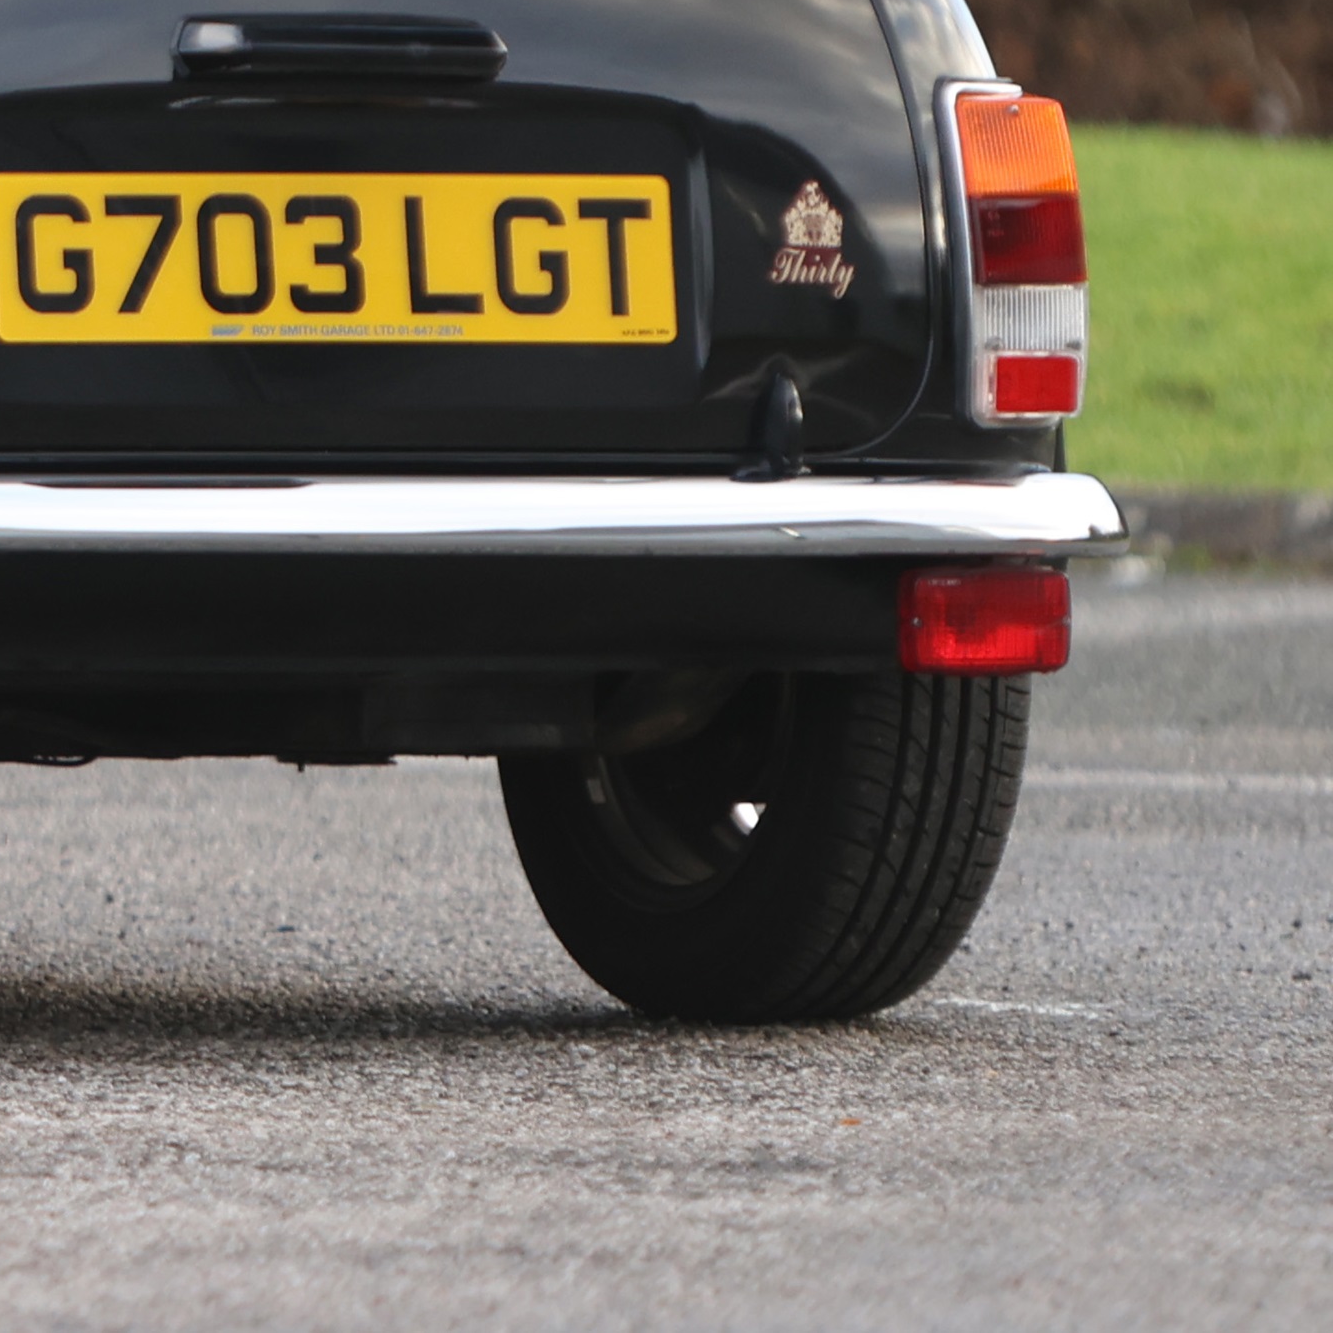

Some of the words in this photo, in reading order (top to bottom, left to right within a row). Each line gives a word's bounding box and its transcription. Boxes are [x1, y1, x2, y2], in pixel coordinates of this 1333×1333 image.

[14, 192, 366, 315] G703
[404, 195, 652, 317] LGT
[771, 248, 854, 299] Thirty
[252, 324, 275, 336] ROY
[279, 324, 318, 336] SMITH
[321, 324, 370, 337] GARAGE
[373, 325, 395, 337] LTD
